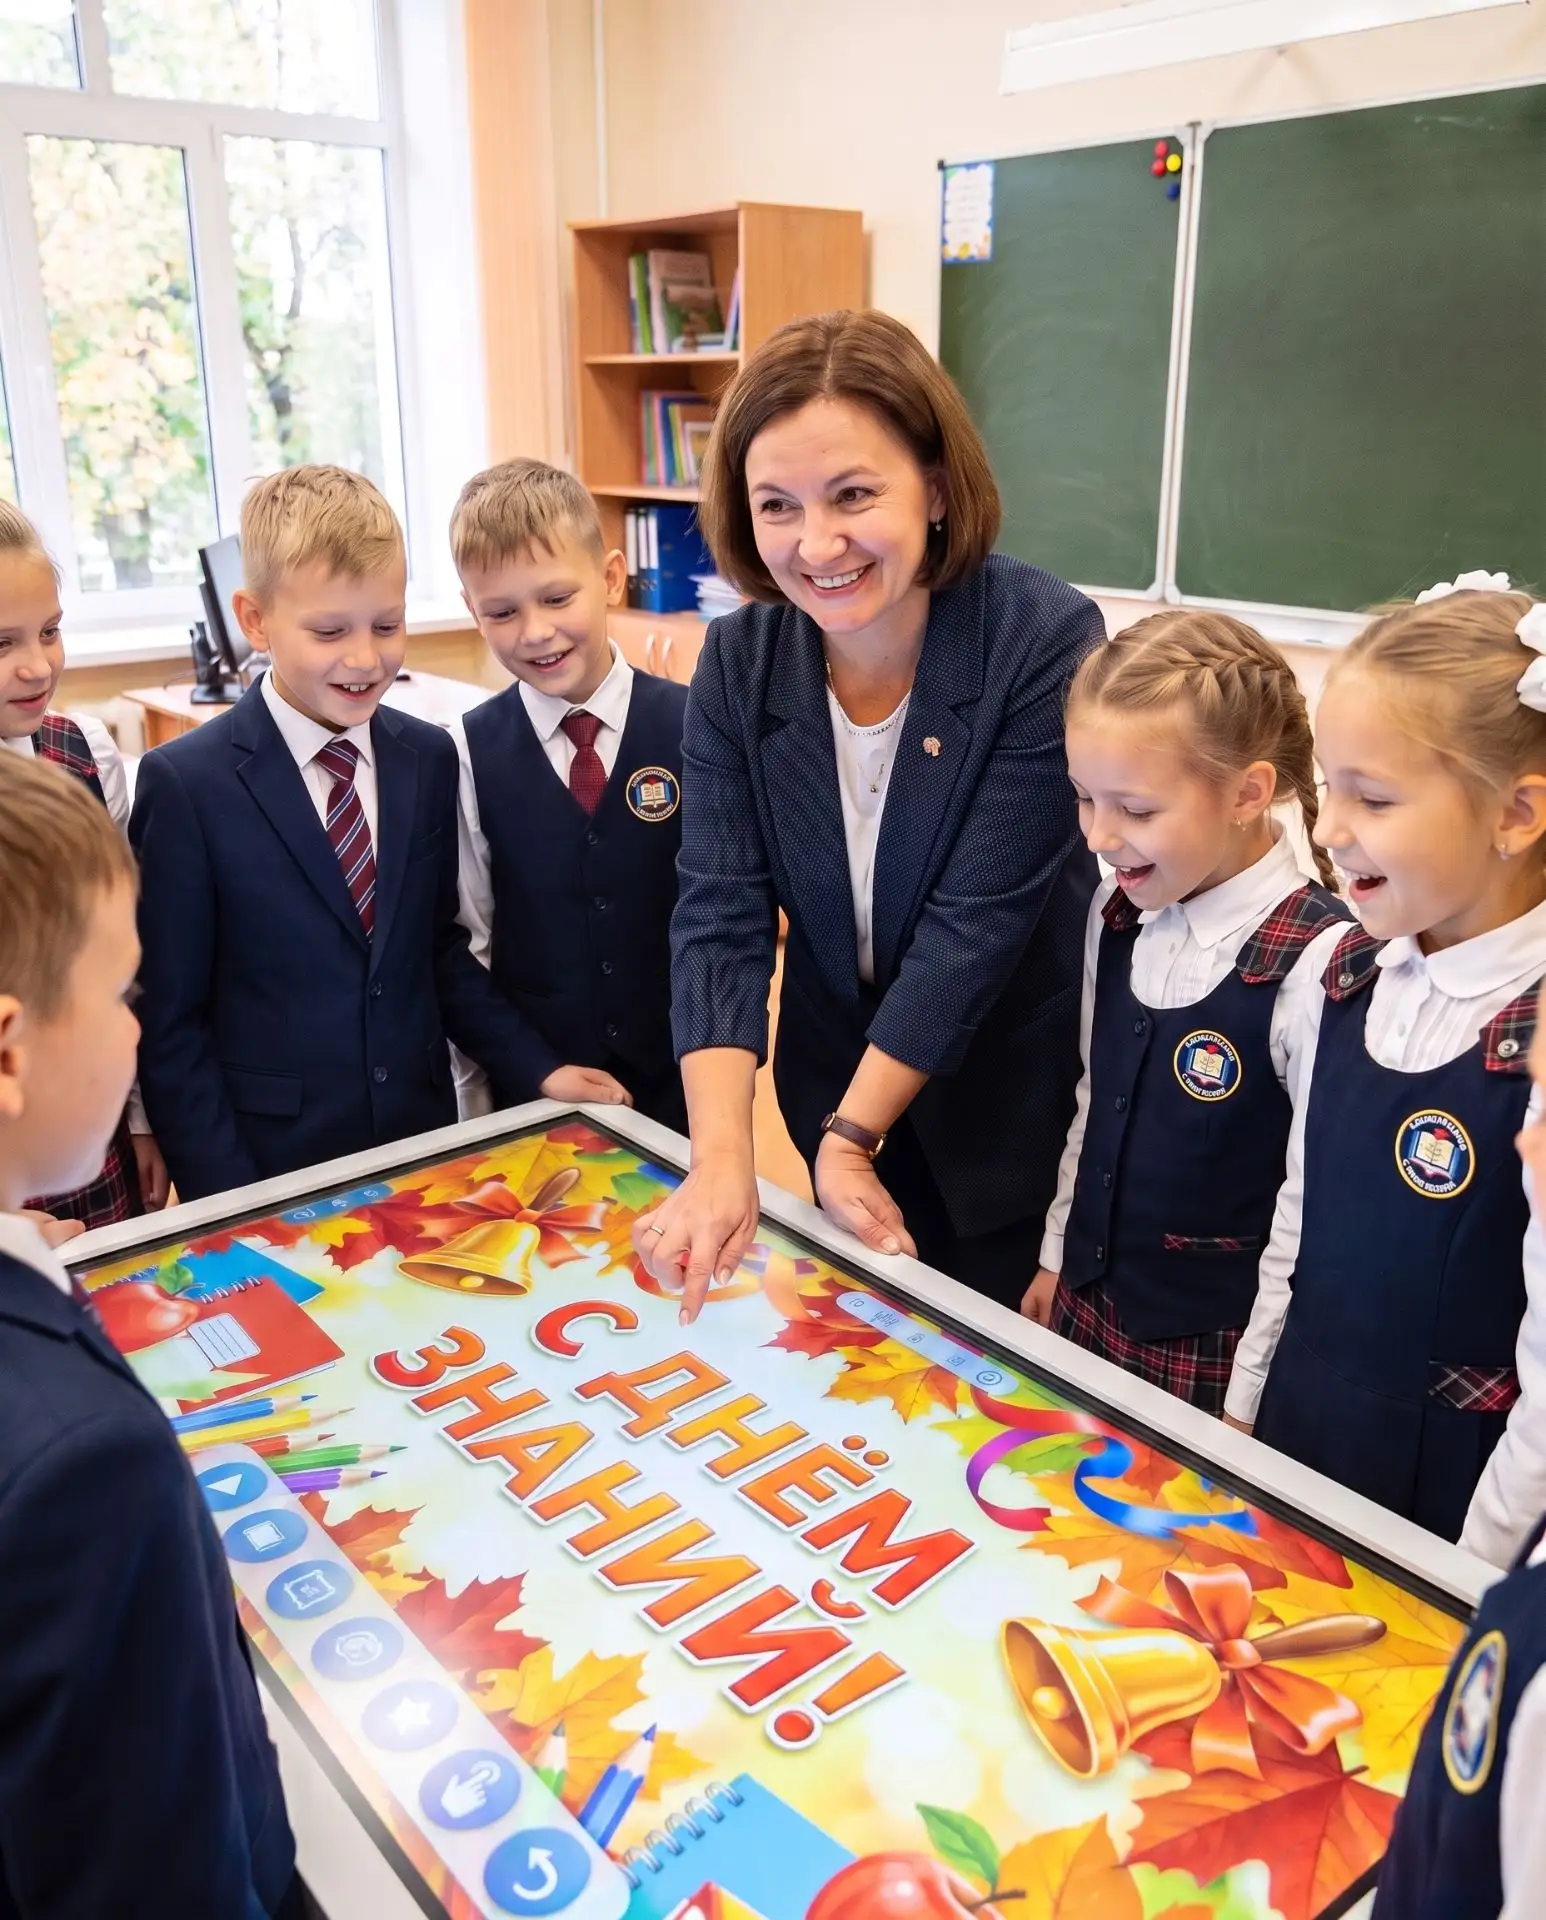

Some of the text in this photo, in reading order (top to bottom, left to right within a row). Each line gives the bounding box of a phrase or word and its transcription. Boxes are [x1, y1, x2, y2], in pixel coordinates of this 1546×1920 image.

[370, 1324, 909, 1749] ЗНАНИЙ!
[532, 1298, 977, 1609] С ДНЁМ
